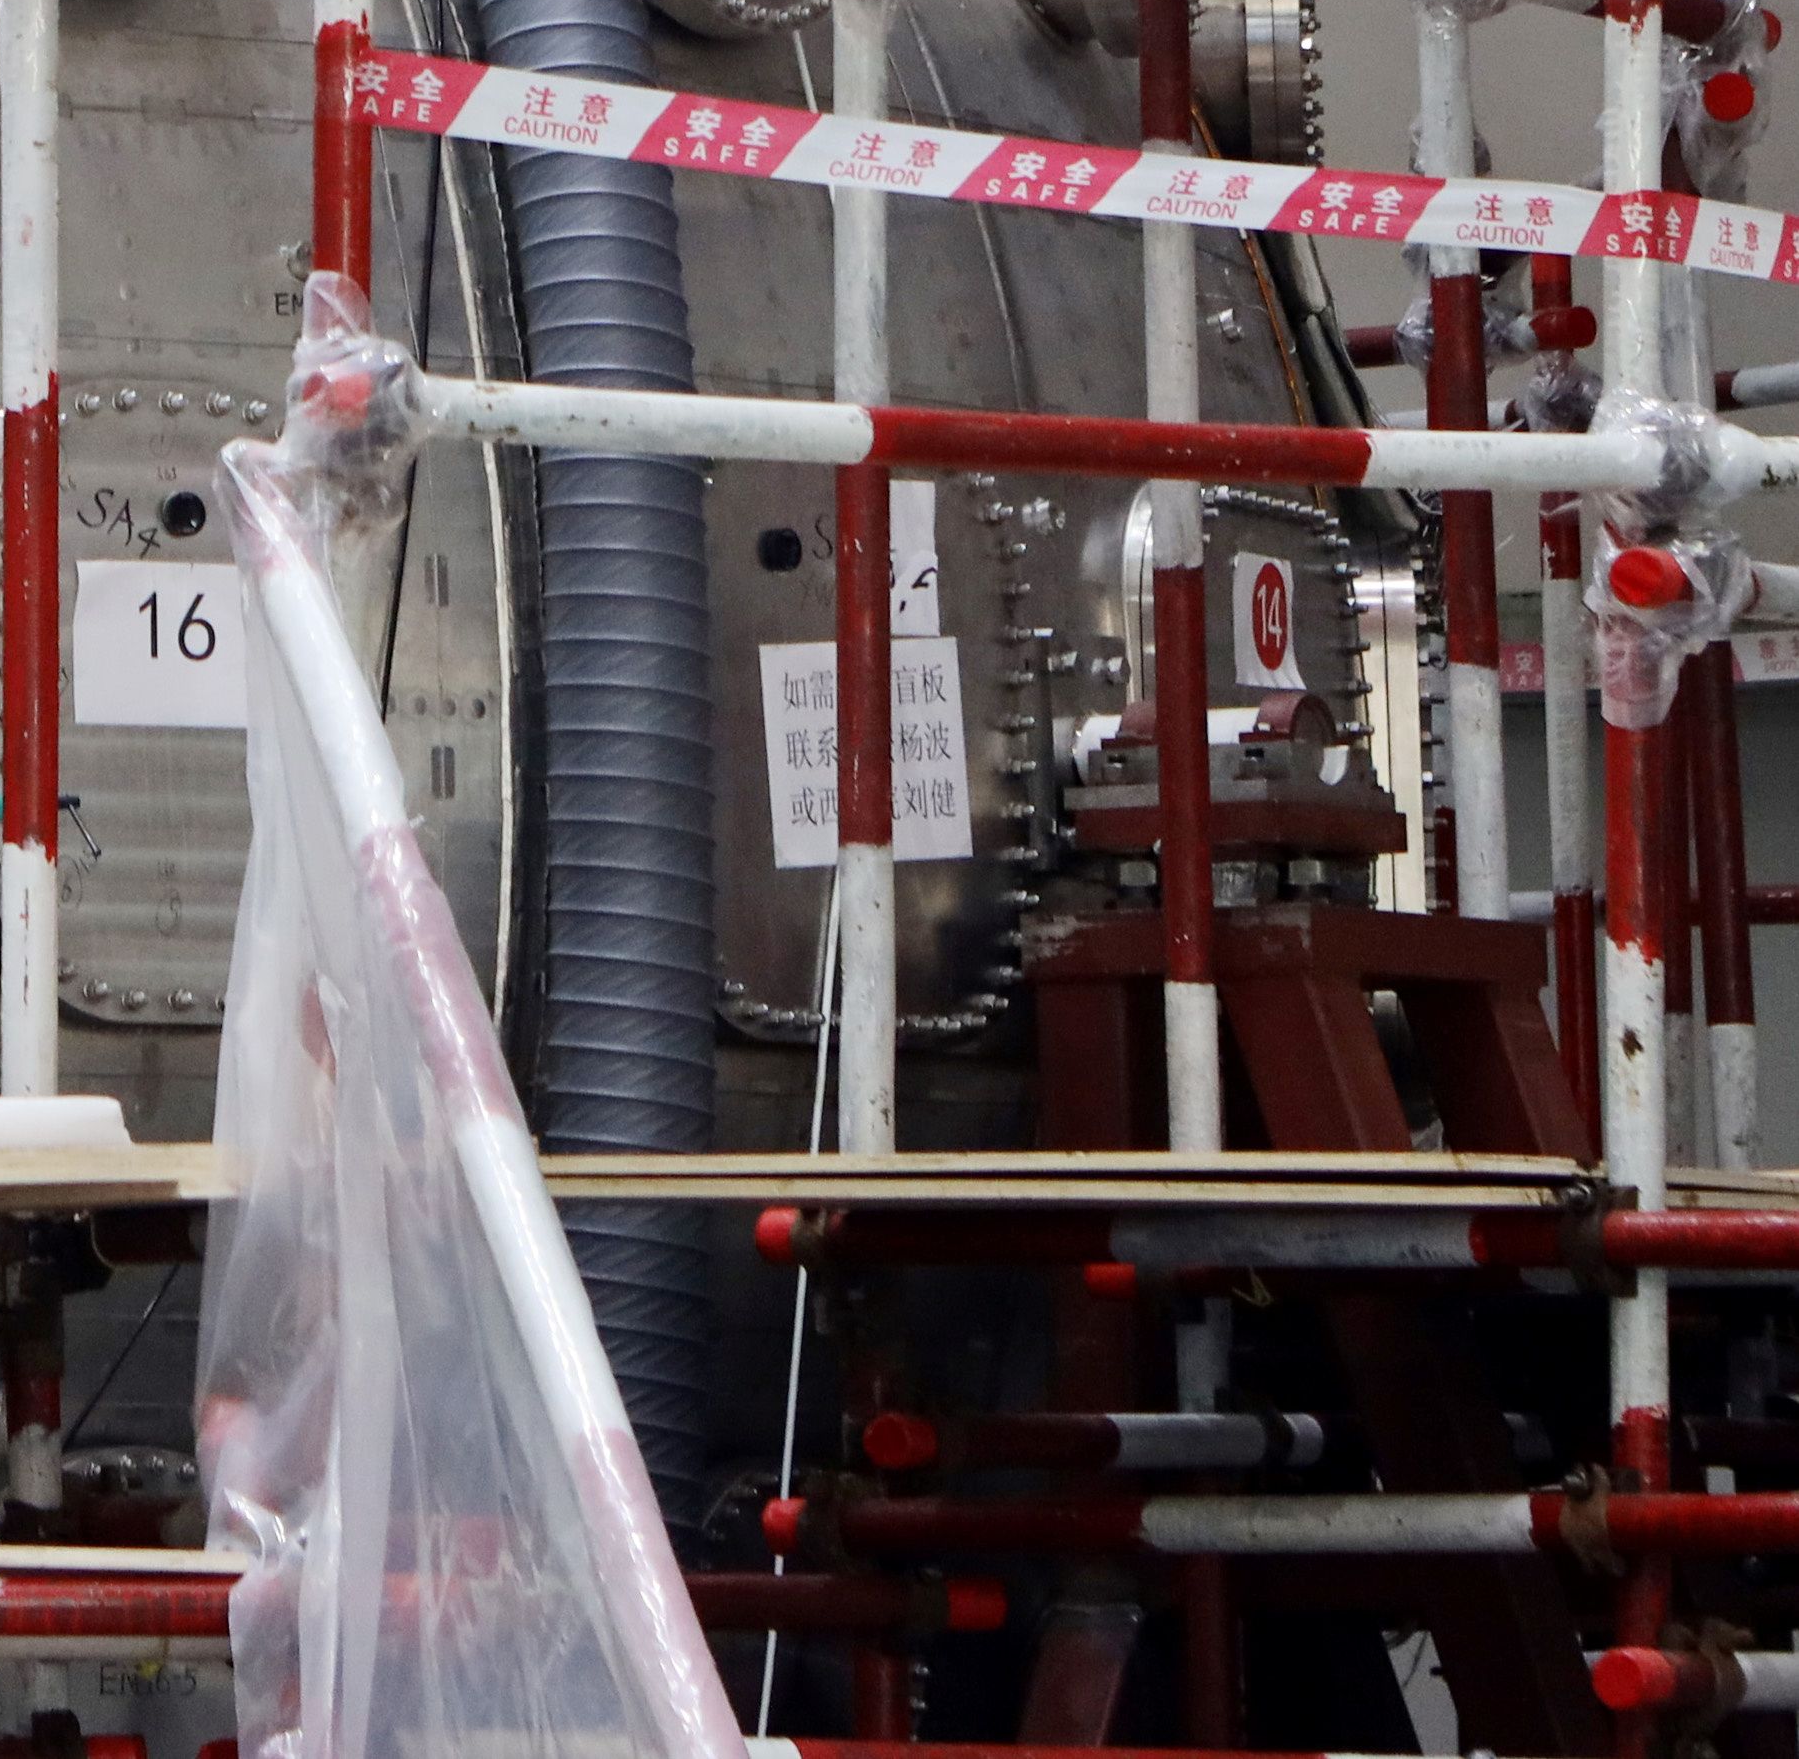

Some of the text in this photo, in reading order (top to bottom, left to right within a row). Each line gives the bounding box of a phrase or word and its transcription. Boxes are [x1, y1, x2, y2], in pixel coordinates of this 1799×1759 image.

[353, 61, 445, 103] 安全
[362, 97, 432, 124] AFE
[524, 85, 612, 125] 注意
[504, 117, 598, 146] CAUTION
[685, 107, 777, 149] 安全
[663, 136, 760, 170] SAFE
[850, 131, 942, 170] 注意
[828, 159, 924, 187] CAUTION
[1007, 151, 1099, 187] 安全
[1166, 169, 1255, 201] 注意
[984, 178, 1080, 207] SAFE
[1146, 195, 1238, 221] CAUTION
[1319, 180, 1404, 217] 安全
[1297, 208, 1390, 236] SAFE
[1474, 193, 1554, 227] 注意
[1620, 201, 1683, 239] 安全
[1456, 223, 1545, 247] CAUTION
[1717, 216, 1760, 253] 注意
[1709, 247, 1755, 271] CAUTION
[137, 592, 217, 663] 16
[1256, 583, 1283, 649] 14
